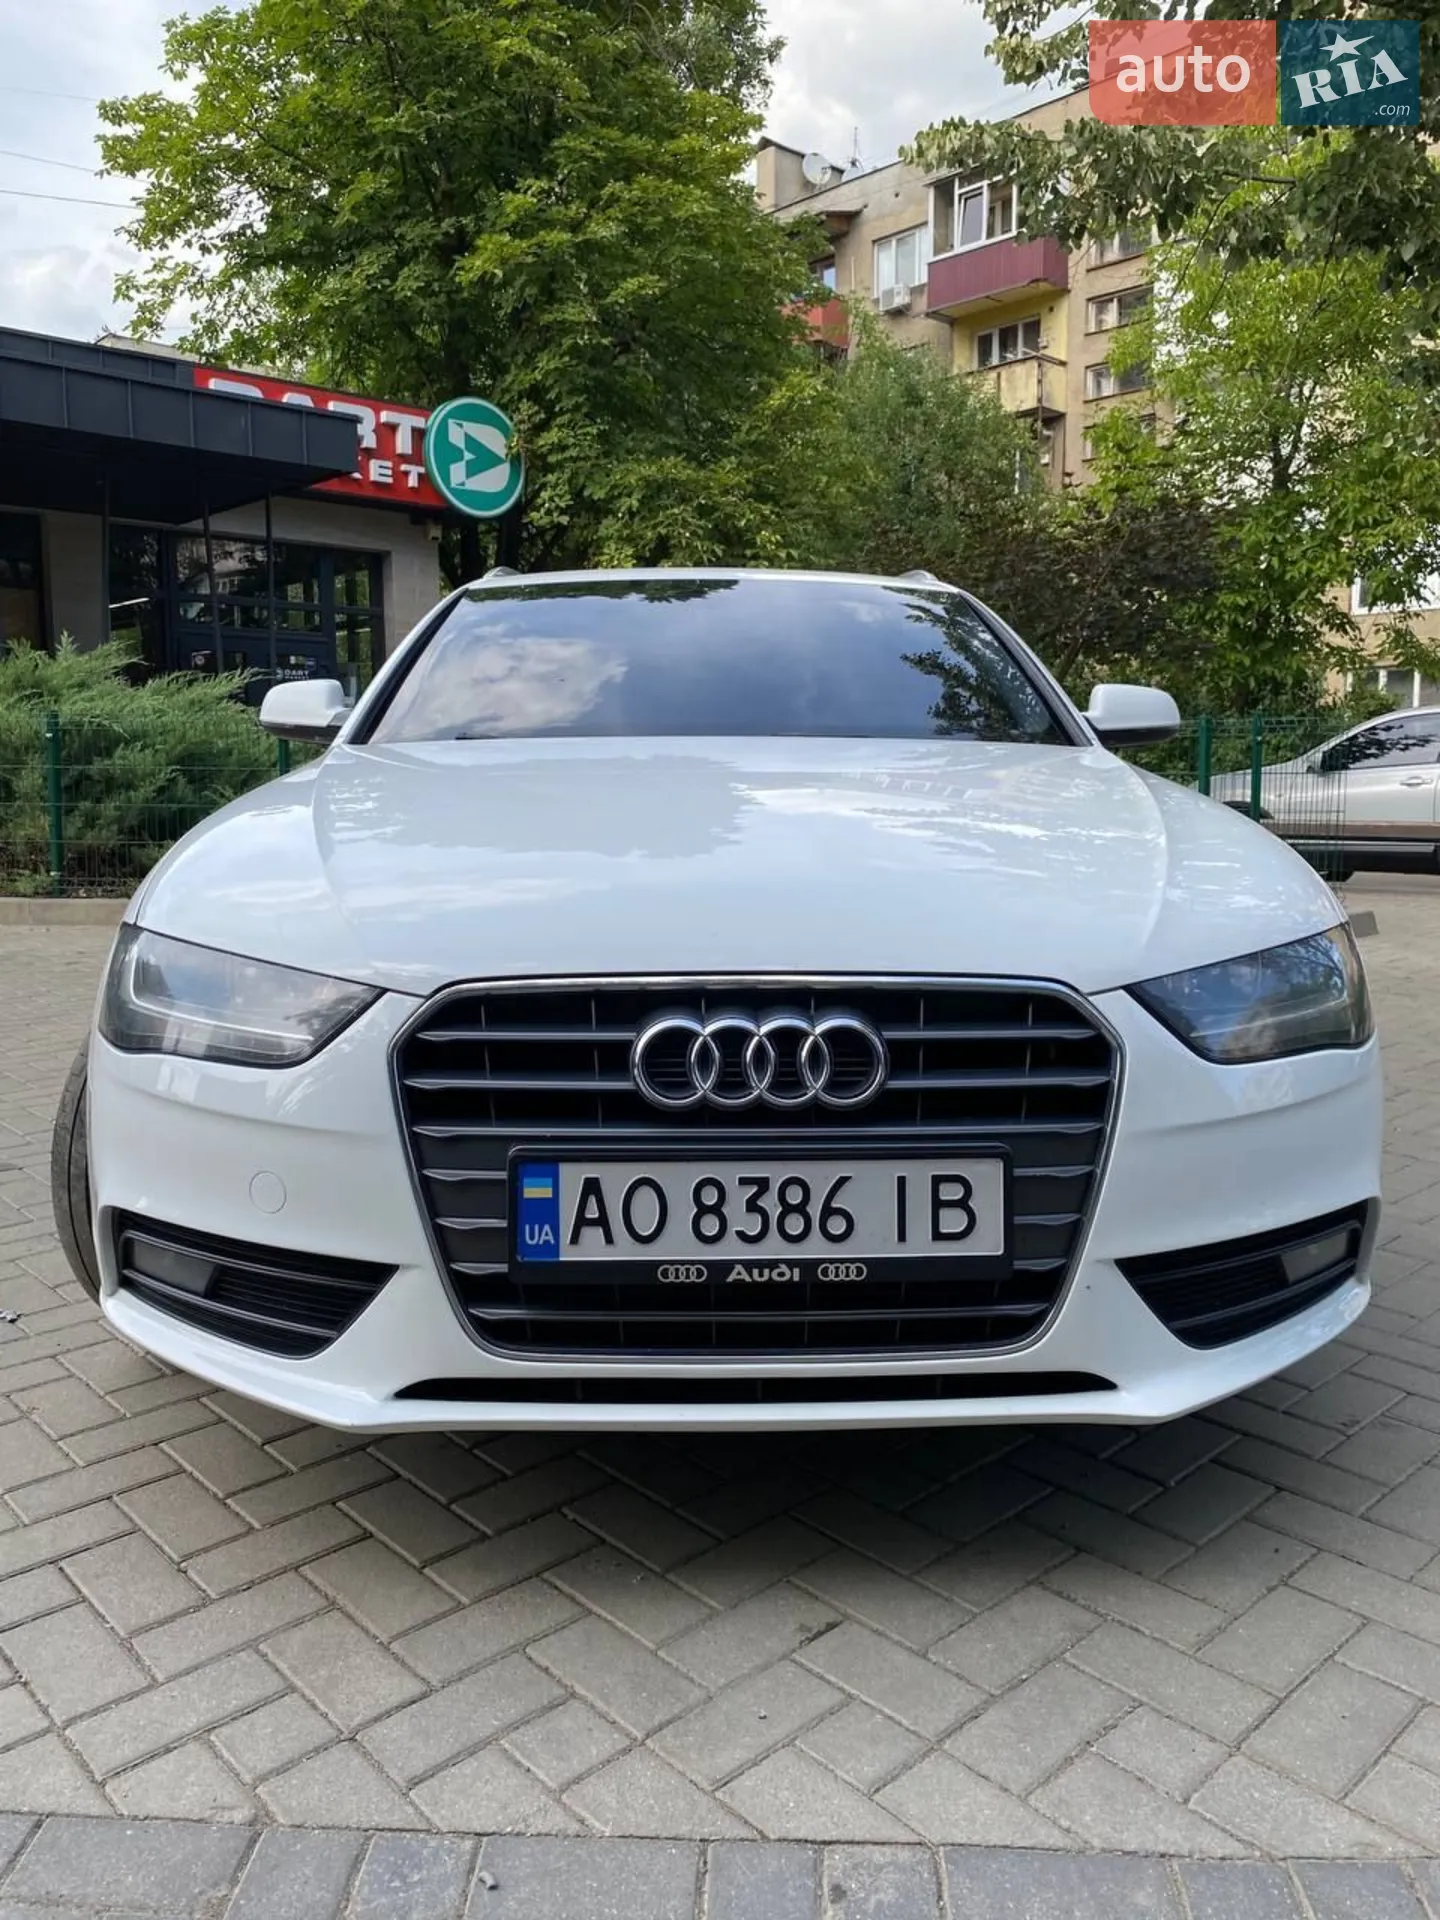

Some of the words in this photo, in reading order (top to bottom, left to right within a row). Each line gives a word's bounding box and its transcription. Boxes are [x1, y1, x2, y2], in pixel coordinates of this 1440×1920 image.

[568, 1174, 668, 1246] AO
[690, 1174, 855, 1245] 8386
[895, 1172, 978, 1243] IB
[524, 1224, 555, 1246] UA
[725, 1263, 800, 1282] Audi
